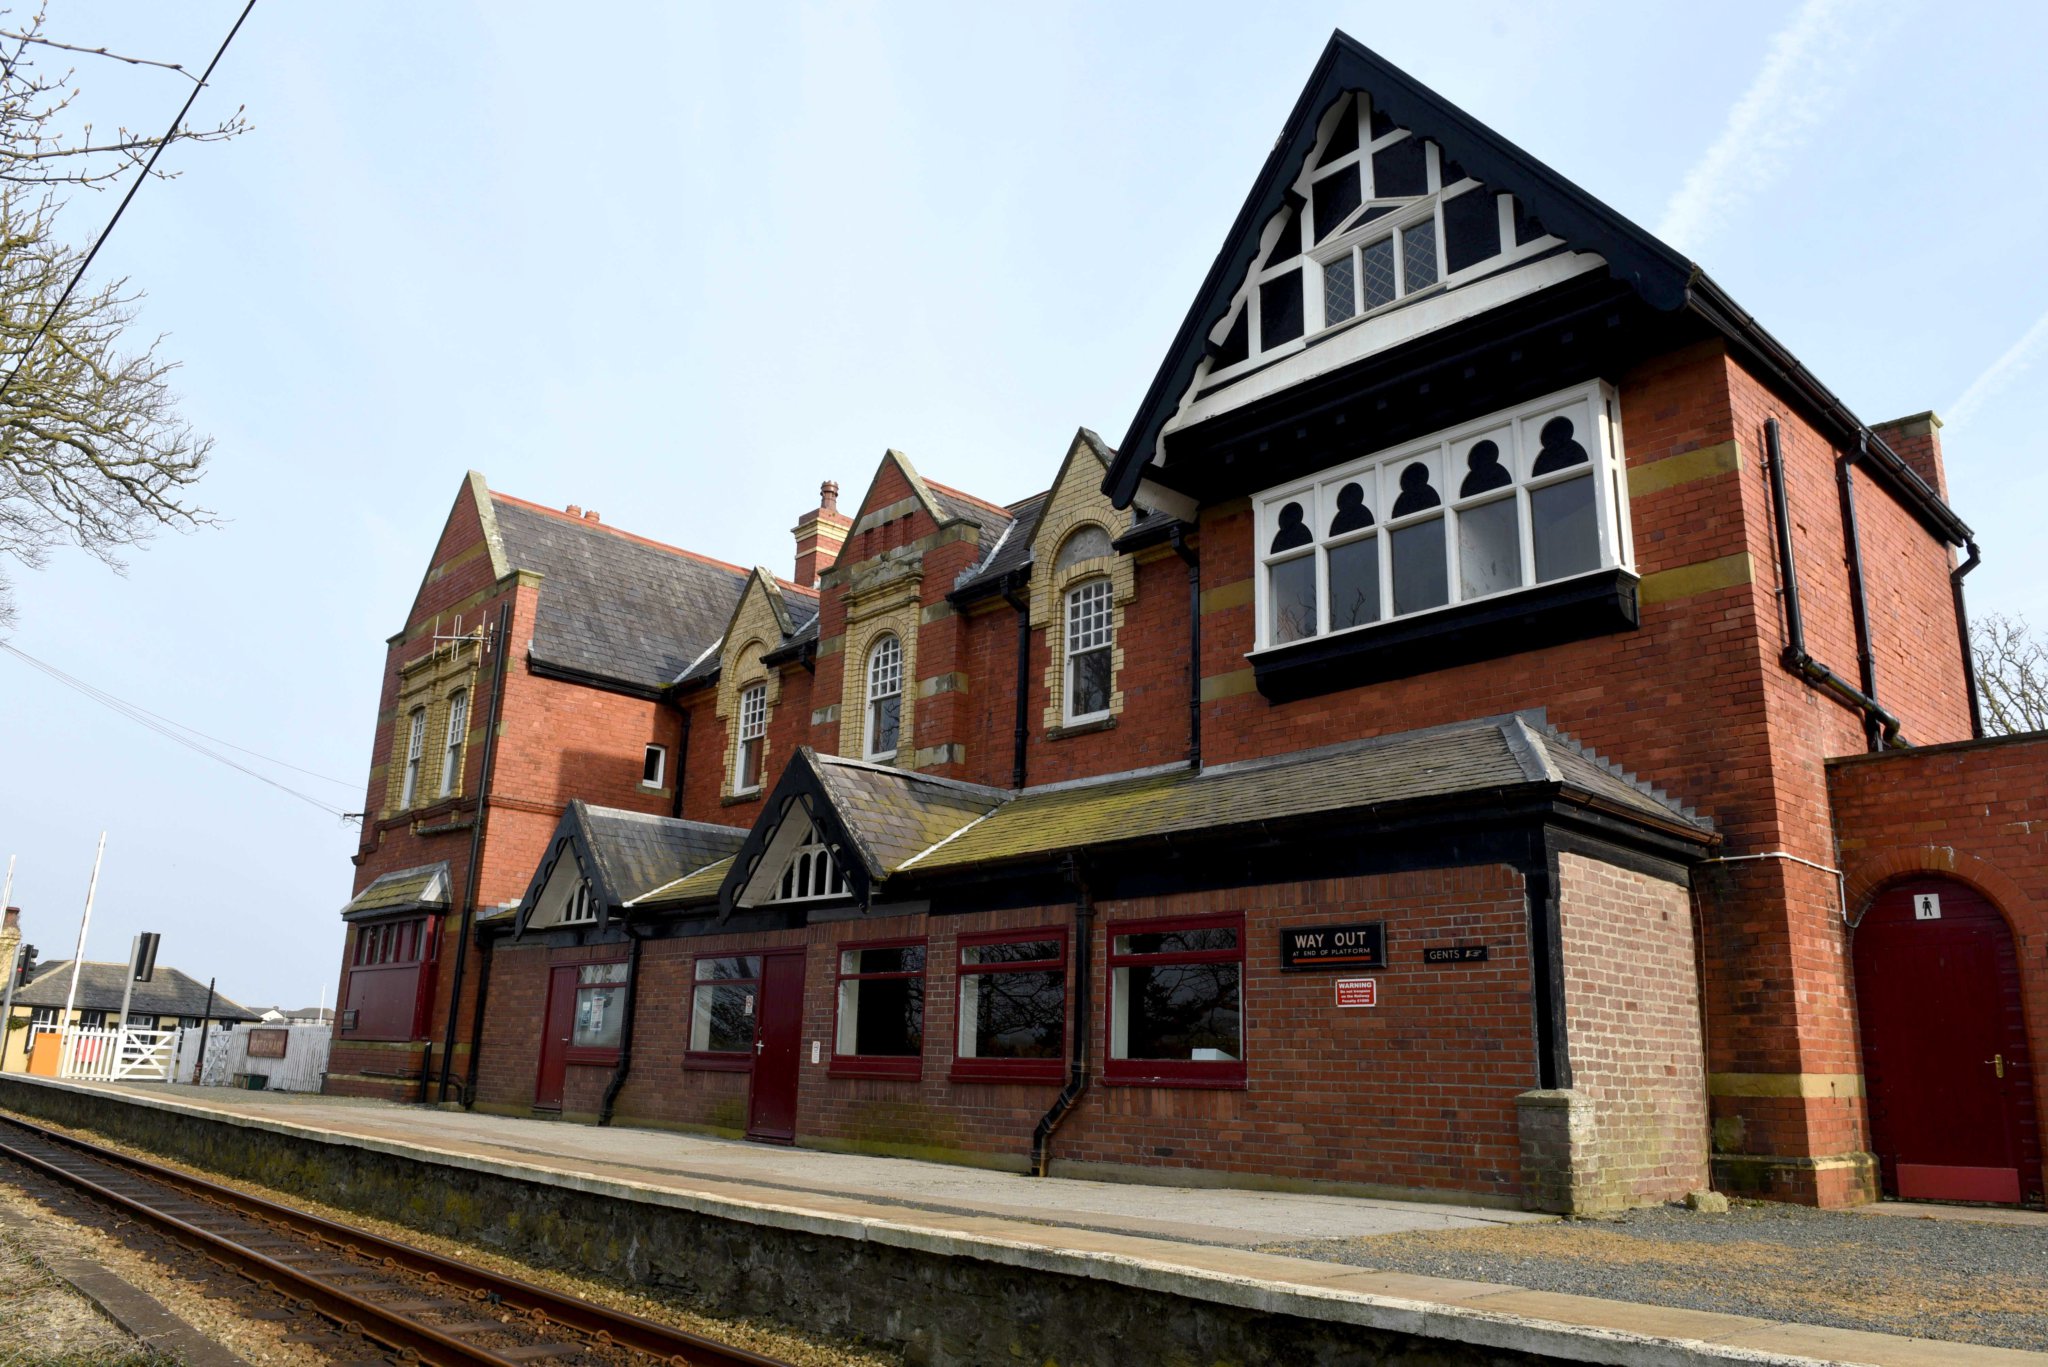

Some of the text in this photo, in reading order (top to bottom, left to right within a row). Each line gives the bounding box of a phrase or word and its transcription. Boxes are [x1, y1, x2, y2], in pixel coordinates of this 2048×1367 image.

[1294, 931, 1366, 949] WAY OUT
[1331, 947, 1370, 955] PLATFORM
[1429, 949, 1460, 960] GENTS
